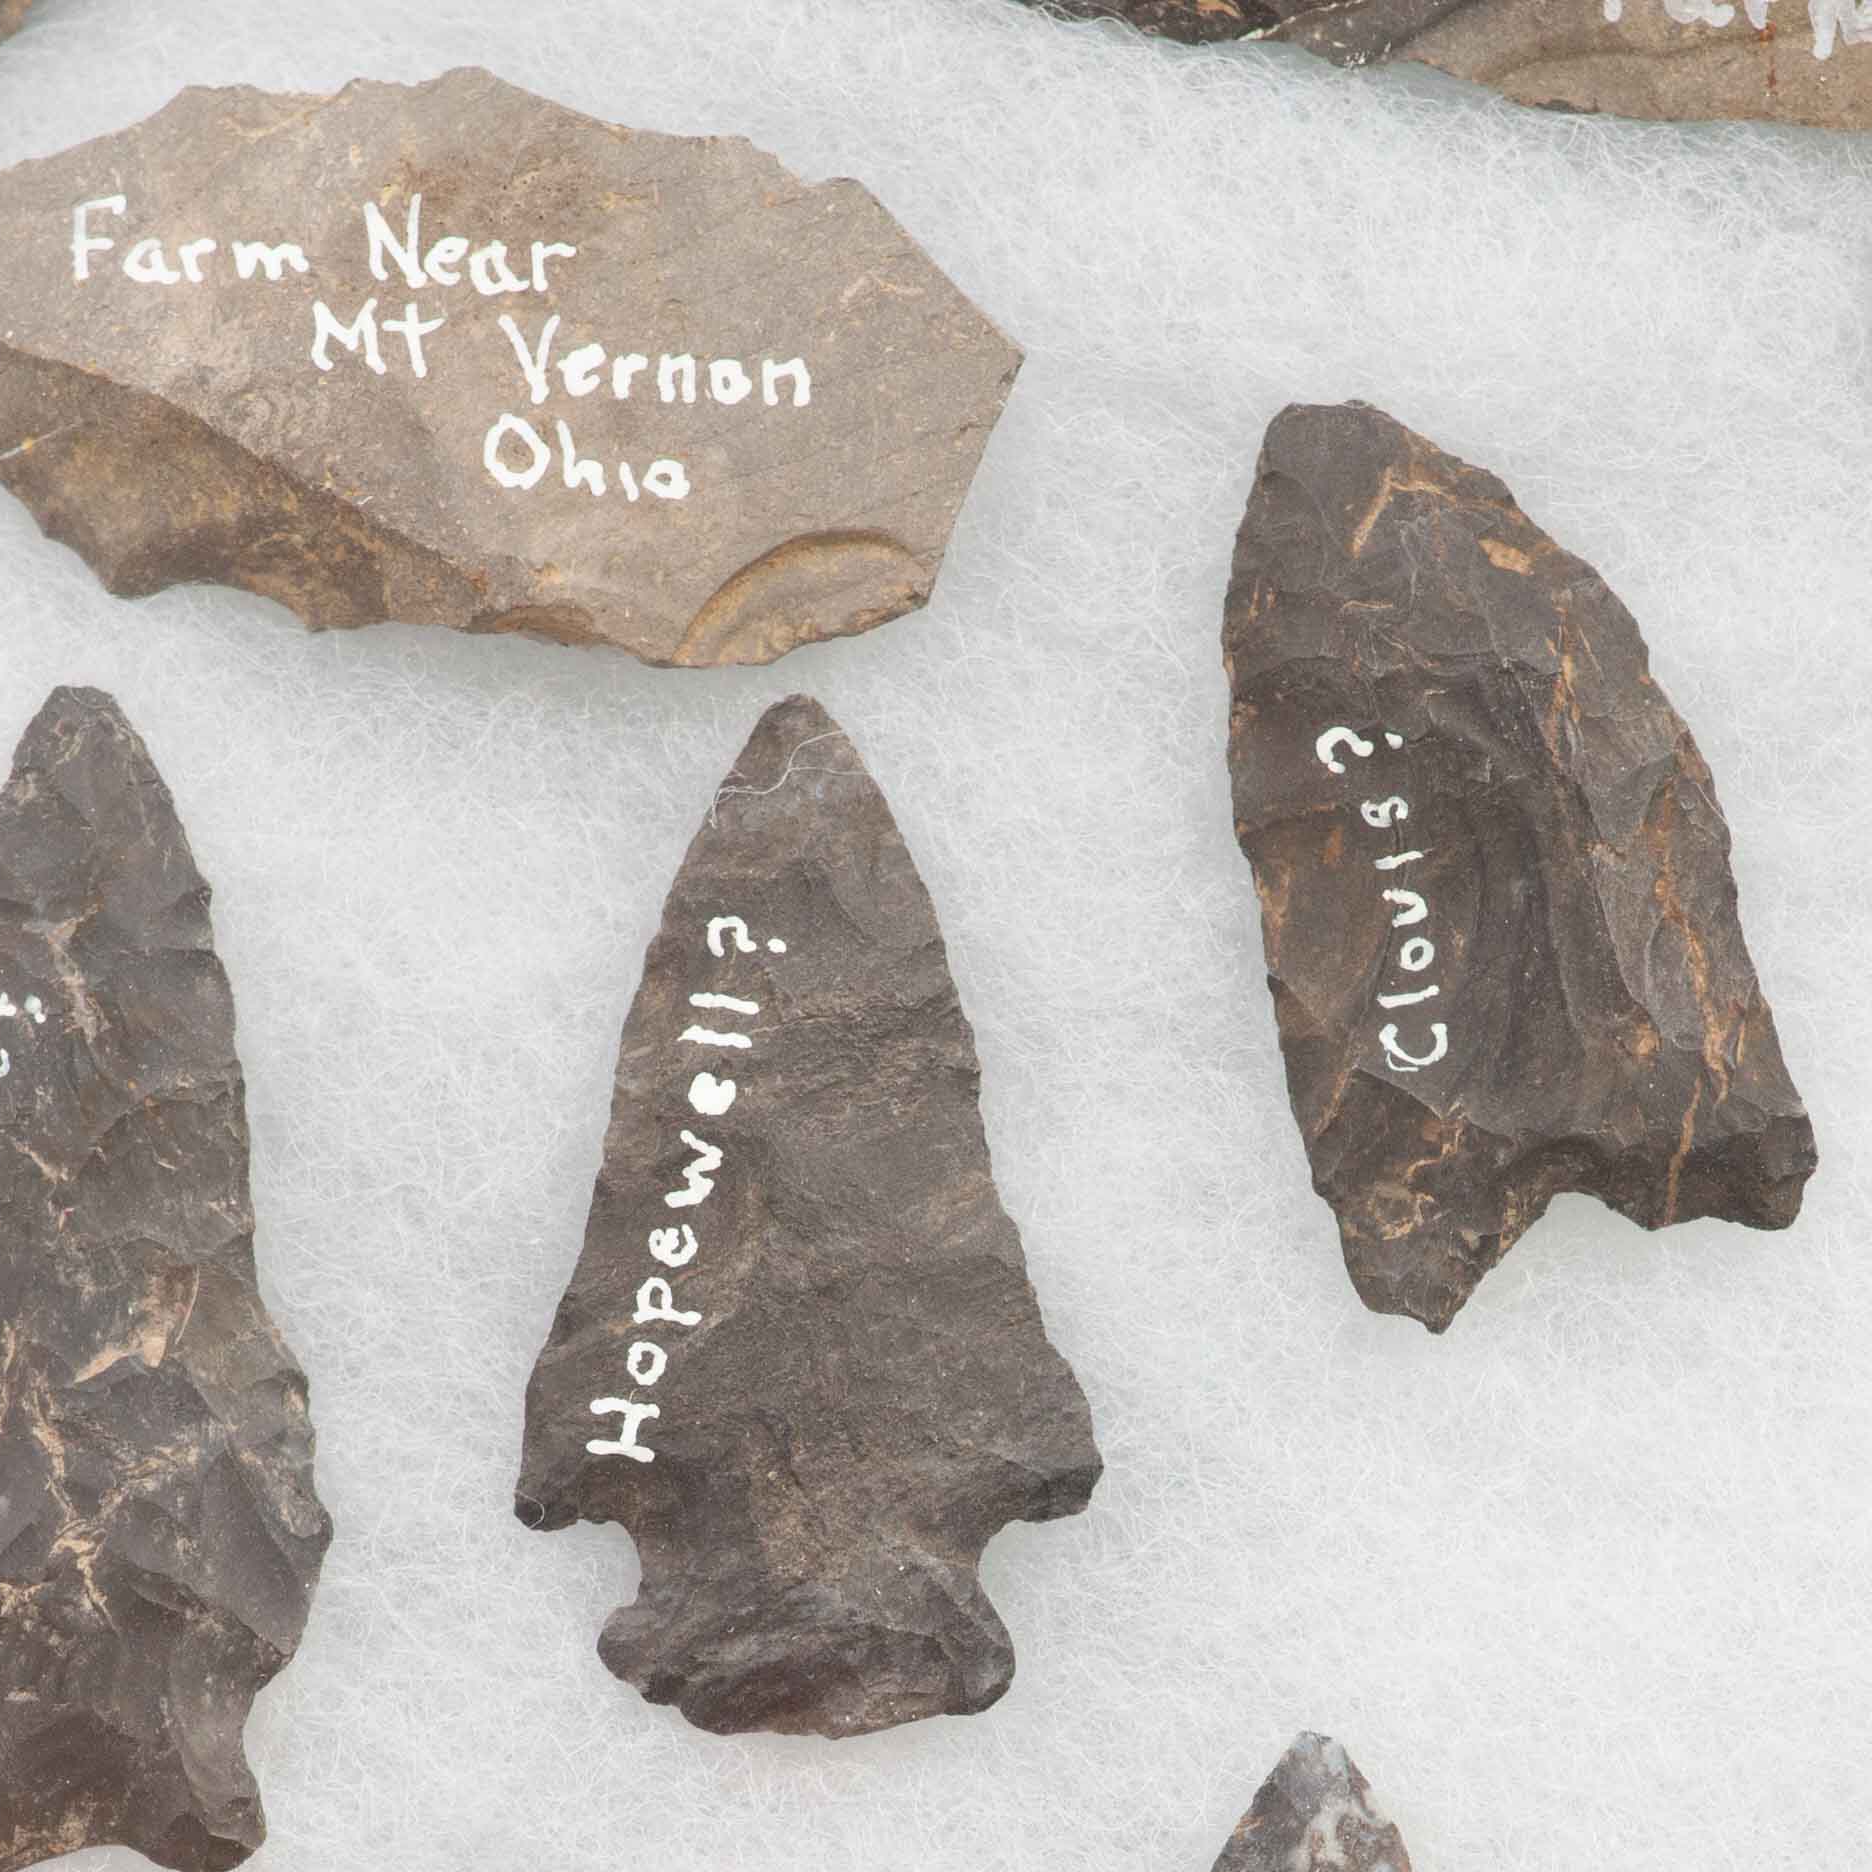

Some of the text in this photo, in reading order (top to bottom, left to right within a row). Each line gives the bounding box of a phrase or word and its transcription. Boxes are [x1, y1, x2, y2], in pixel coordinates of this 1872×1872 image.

[67, 191, 579, 297] Farm Near
[310, 297, 813, 409] Mt Vernon
[481, 411, 693, 504] Ohio
